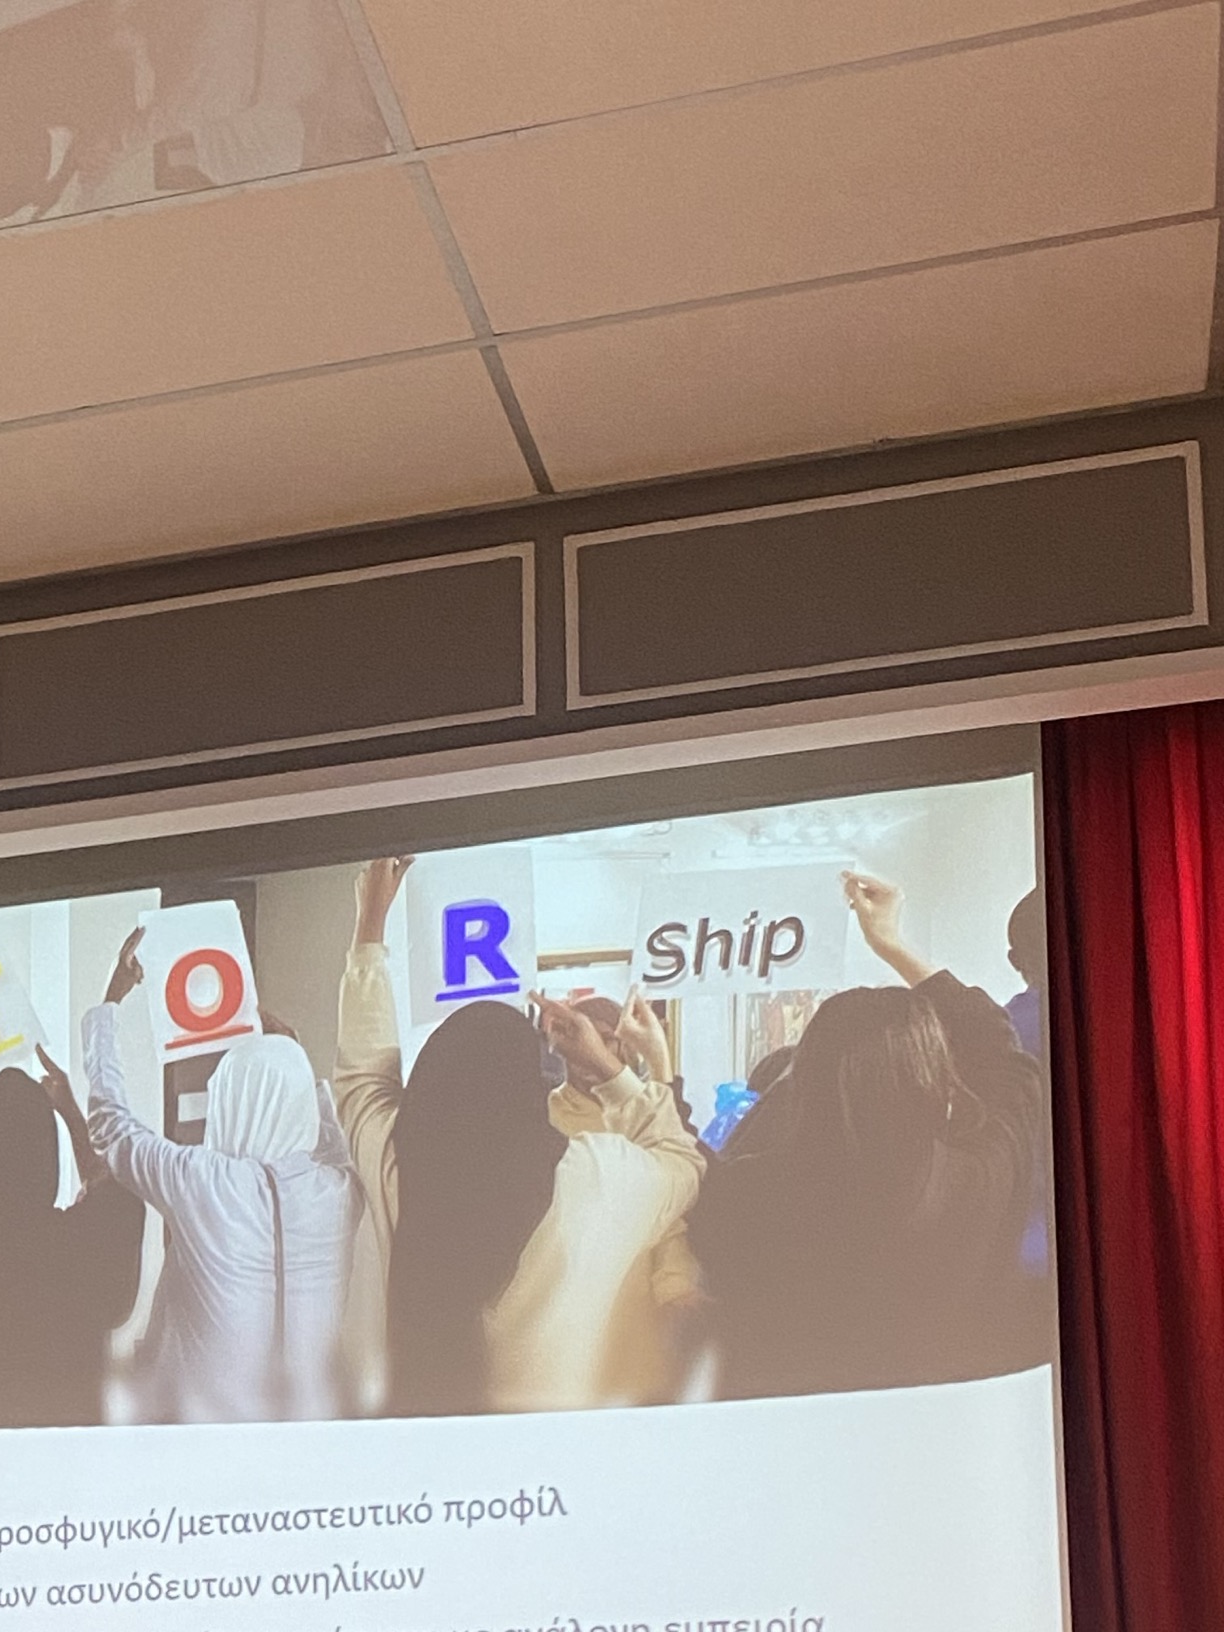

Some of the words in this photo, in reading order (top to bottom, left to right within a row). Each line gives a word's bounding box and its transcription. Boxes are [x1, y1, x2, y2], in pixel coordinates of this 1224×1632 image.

[165, 948, 244, 1033] O
[442, 899, 520, 986] R
[642, 910, 805, 985] Ship
[442, 1485, 569, 1529] προφίλ
[46, 1570, 262, 1606] ασυνόδευτων
[271, 1560, 425, 1601] ανηλίκων
